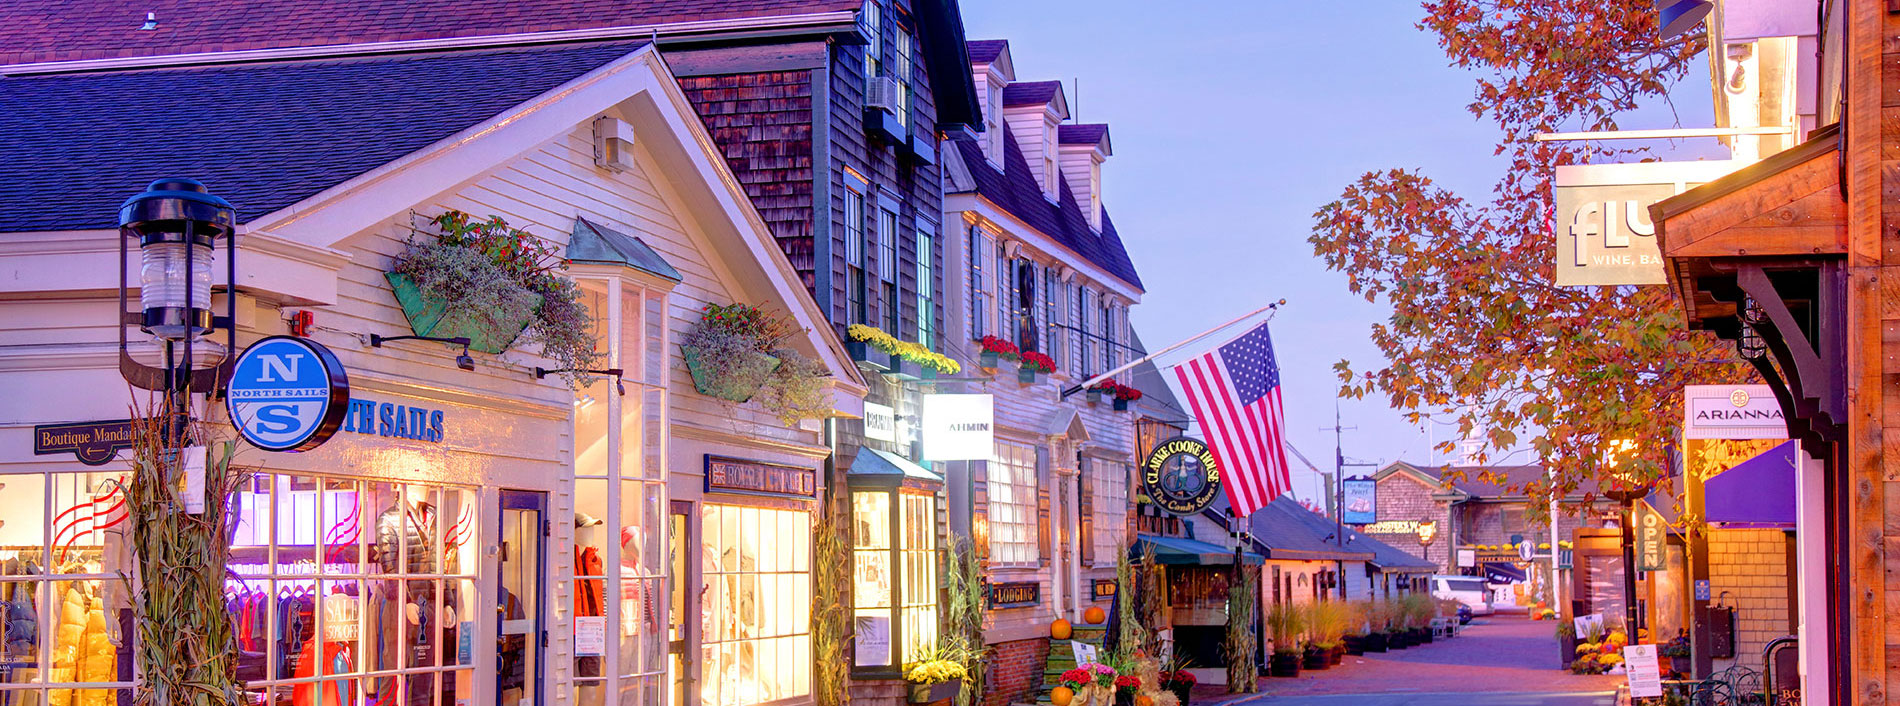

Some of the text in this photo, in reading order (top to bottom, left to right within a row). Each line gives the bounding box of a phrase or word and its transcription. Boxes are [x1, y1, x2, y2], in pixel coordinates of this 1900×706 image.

[1593, 254, 1664, 266] WINE, BA
[256, 354, 304, 382] N
[232, 388, 328, 397] NORTH SAILS
[256, 404, 301, 434] S
[380, 402, 444, 443] SAILS
[1696, 410, 1785, 420] ARIANNA
[42, 432, 90, 447] Boutique
[1147, 440, 1219, 484] CLARKE COOKE HOUSE
[1153, 488, 1215, 512] The Candy Store
[1643, 514, 1658, 567] OPEN
[998, 588, 1033, 603] LODGING
[327, 599, 358, 622] SALE
[344, 624, 358, 639] OFF
